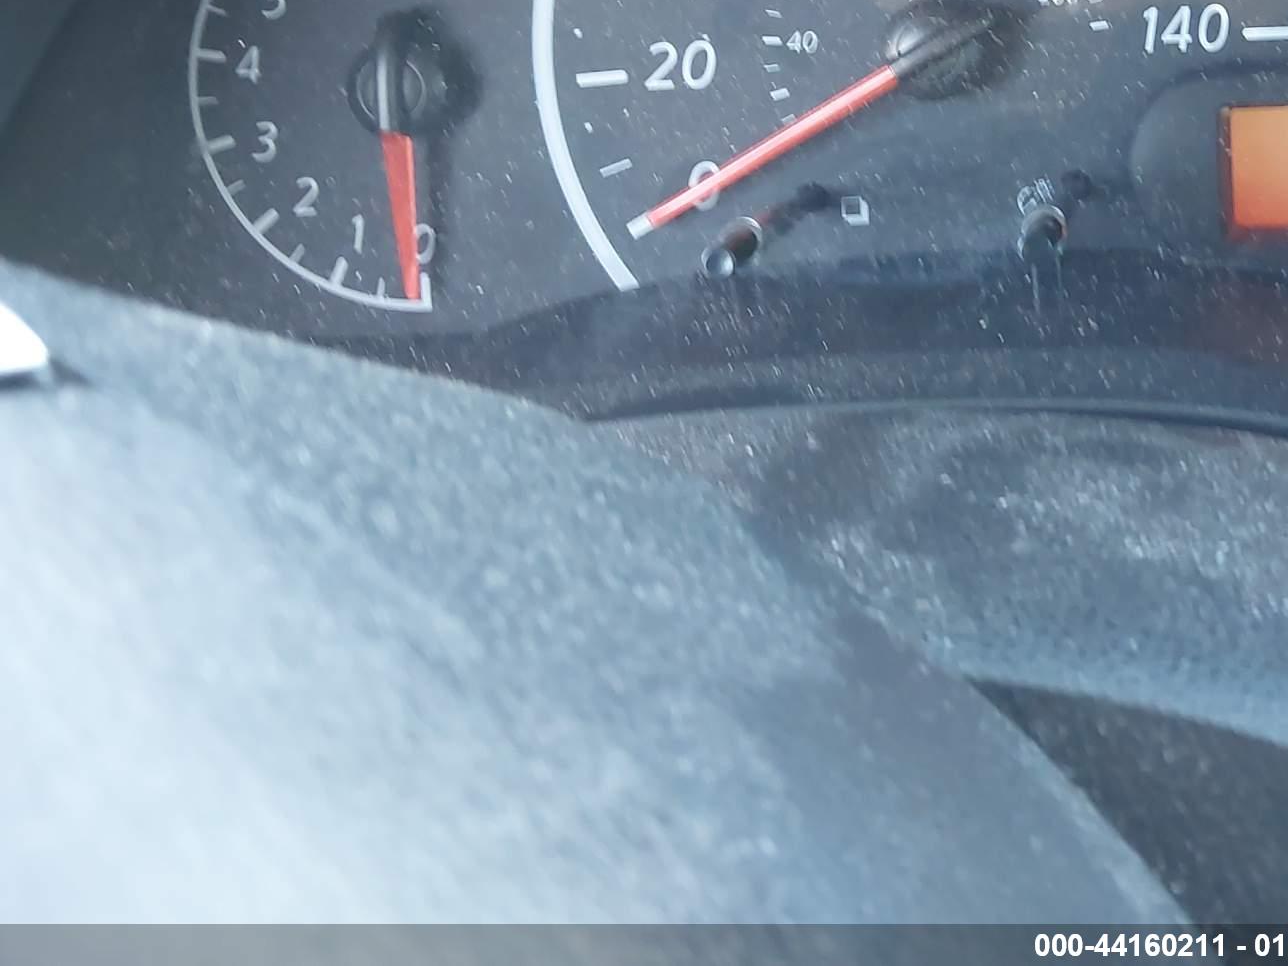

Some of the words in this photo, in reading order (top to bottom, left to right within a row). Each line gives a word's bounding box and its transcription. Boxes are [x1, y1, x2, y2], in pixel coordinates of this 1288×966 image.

[786, 30, 819, 54] 40
[1142, 3, 1230, 54] 140
[236, 45, 260, 84] 4
[644, 39, 717, 92] 20
[252, 120, 278, 164] 3
[294, 176, 319, 217] 2
[688, 160, 720, 211] 0
[351, 215, 364, 254] 1
[415, 223, 437, 265] 0
